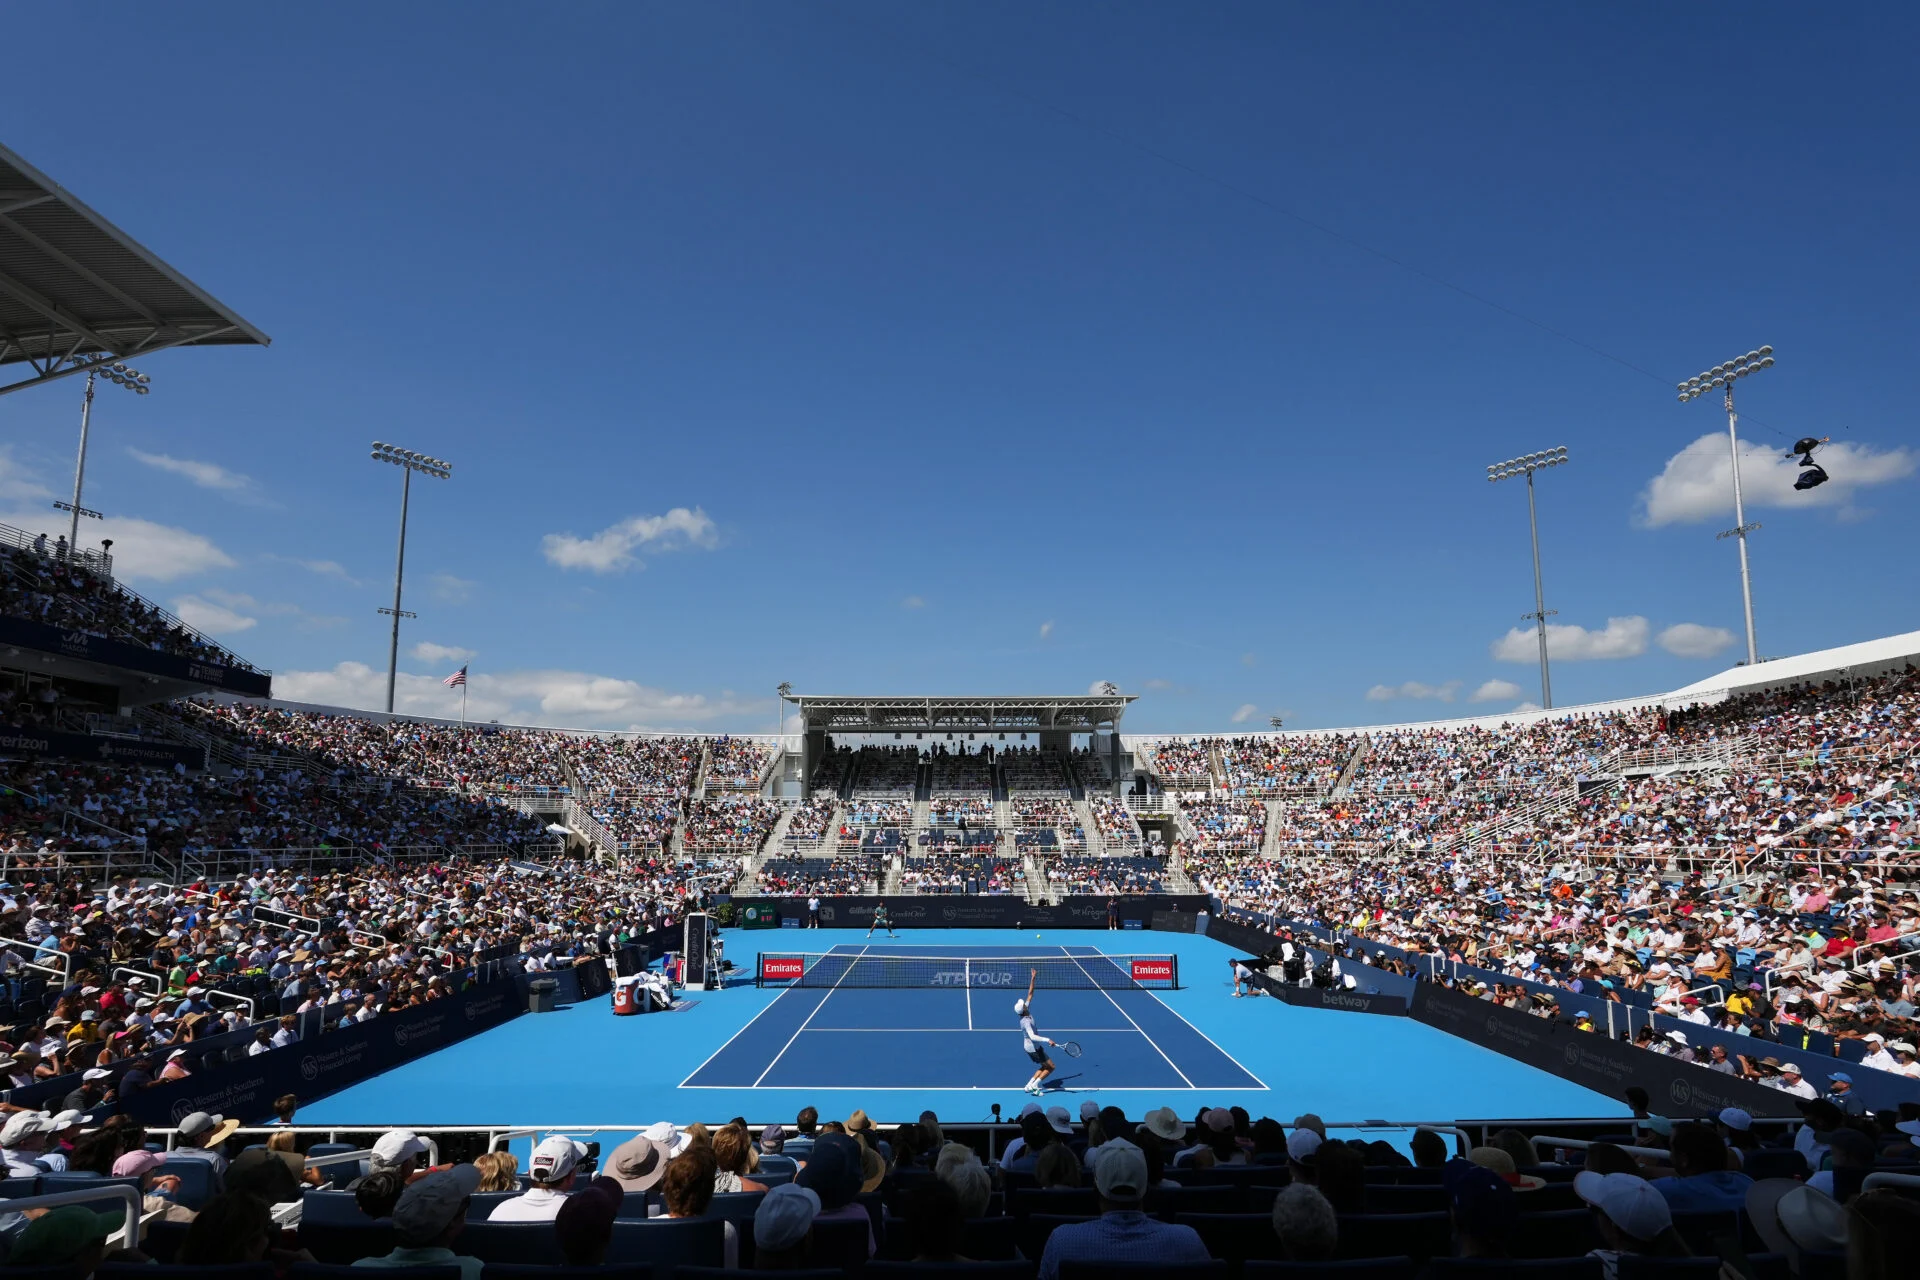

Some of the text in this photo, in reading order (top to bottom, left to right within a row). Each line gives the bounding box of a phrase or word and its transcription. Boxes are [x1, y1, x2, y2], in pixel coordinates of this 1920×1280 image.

[765, 964, 802, 973] Emirates
[1134, 965, 1170, 974] Emirates
[930, 972, 1012, 985] ATP TOUR
[1322, 992, 1371, 1010] betway
